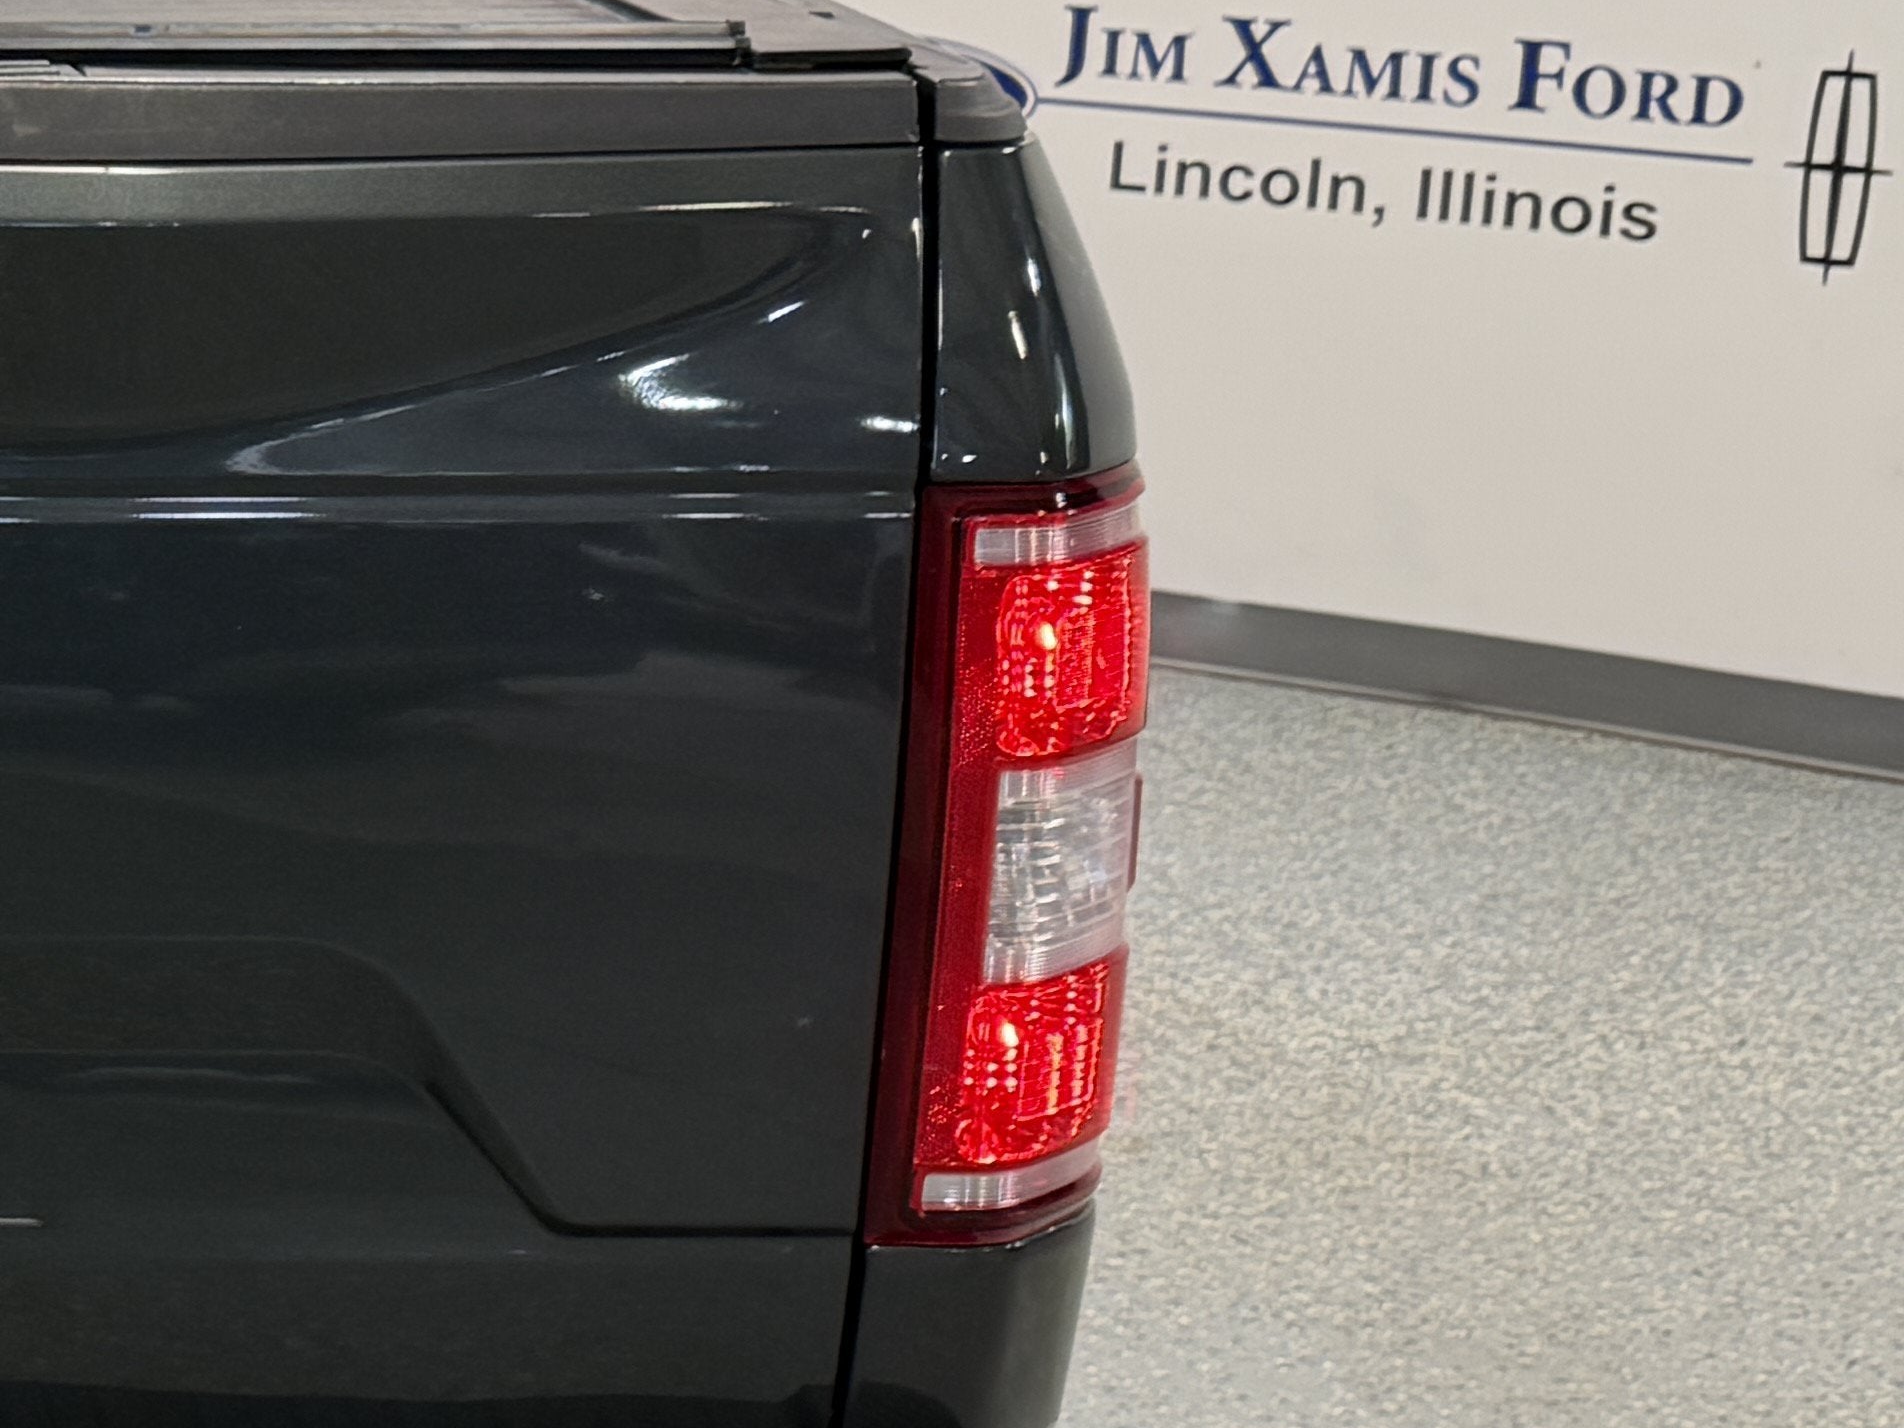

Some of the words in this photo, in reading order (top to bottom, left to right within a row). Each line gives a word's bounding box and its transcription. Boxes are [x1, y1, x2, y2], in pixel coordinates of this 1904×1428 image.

[1054, 3, 1191, 88] JIM
[1213, 15, 1481, 109] XAMIS
[1507, 38, 1745, 128] FORD
[1107, 138, 1387, 229] Lincoln,
[1415, 166, 1659, 243] Illinois
